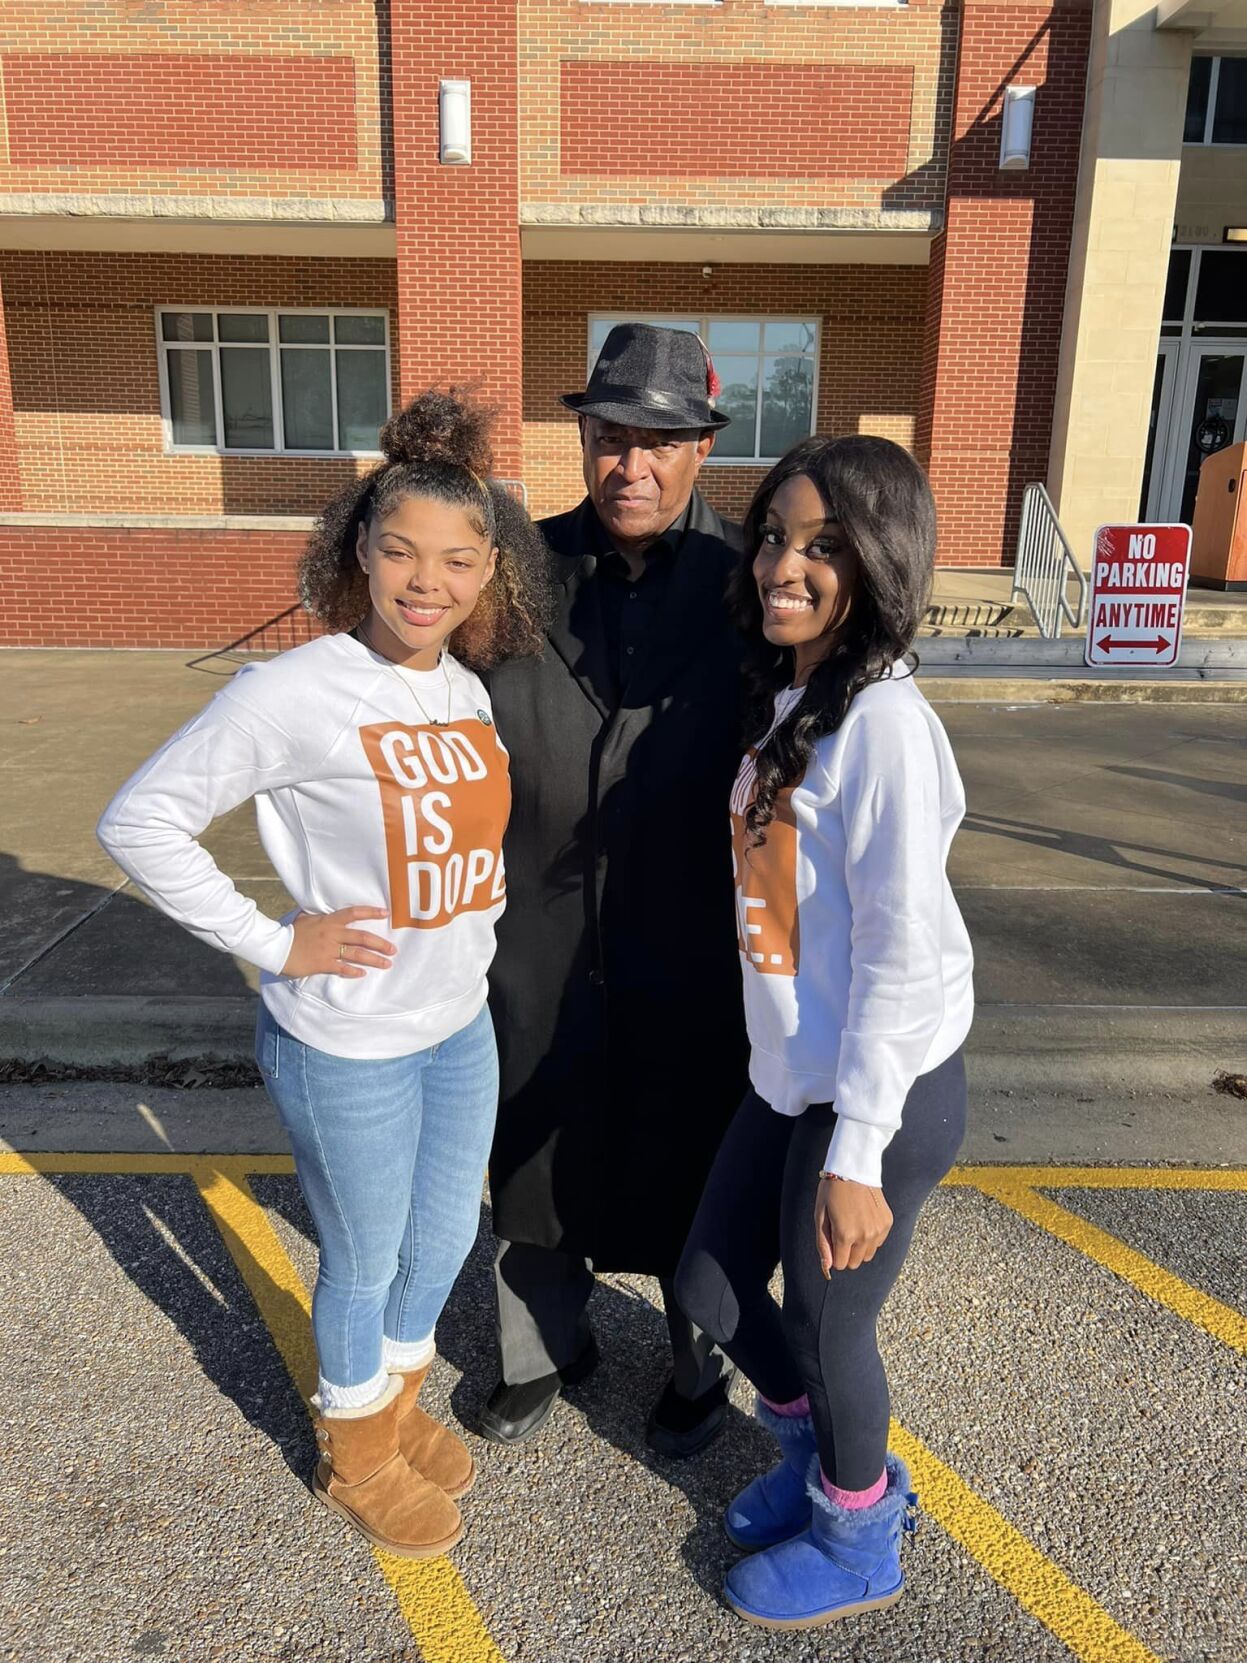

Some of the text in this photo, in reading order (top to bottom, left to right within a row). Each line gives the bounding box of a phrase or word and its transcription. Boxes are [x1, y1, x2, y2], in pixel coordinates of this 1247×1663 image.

[1128, 534, 1156, 559] NO
[1096, 562, 1183, 588] PARKING
[1096, 603, 1176, 628] ANYTIME
[379, 730, 488, 789] GOD
[401, 791, 454, 856] IS
